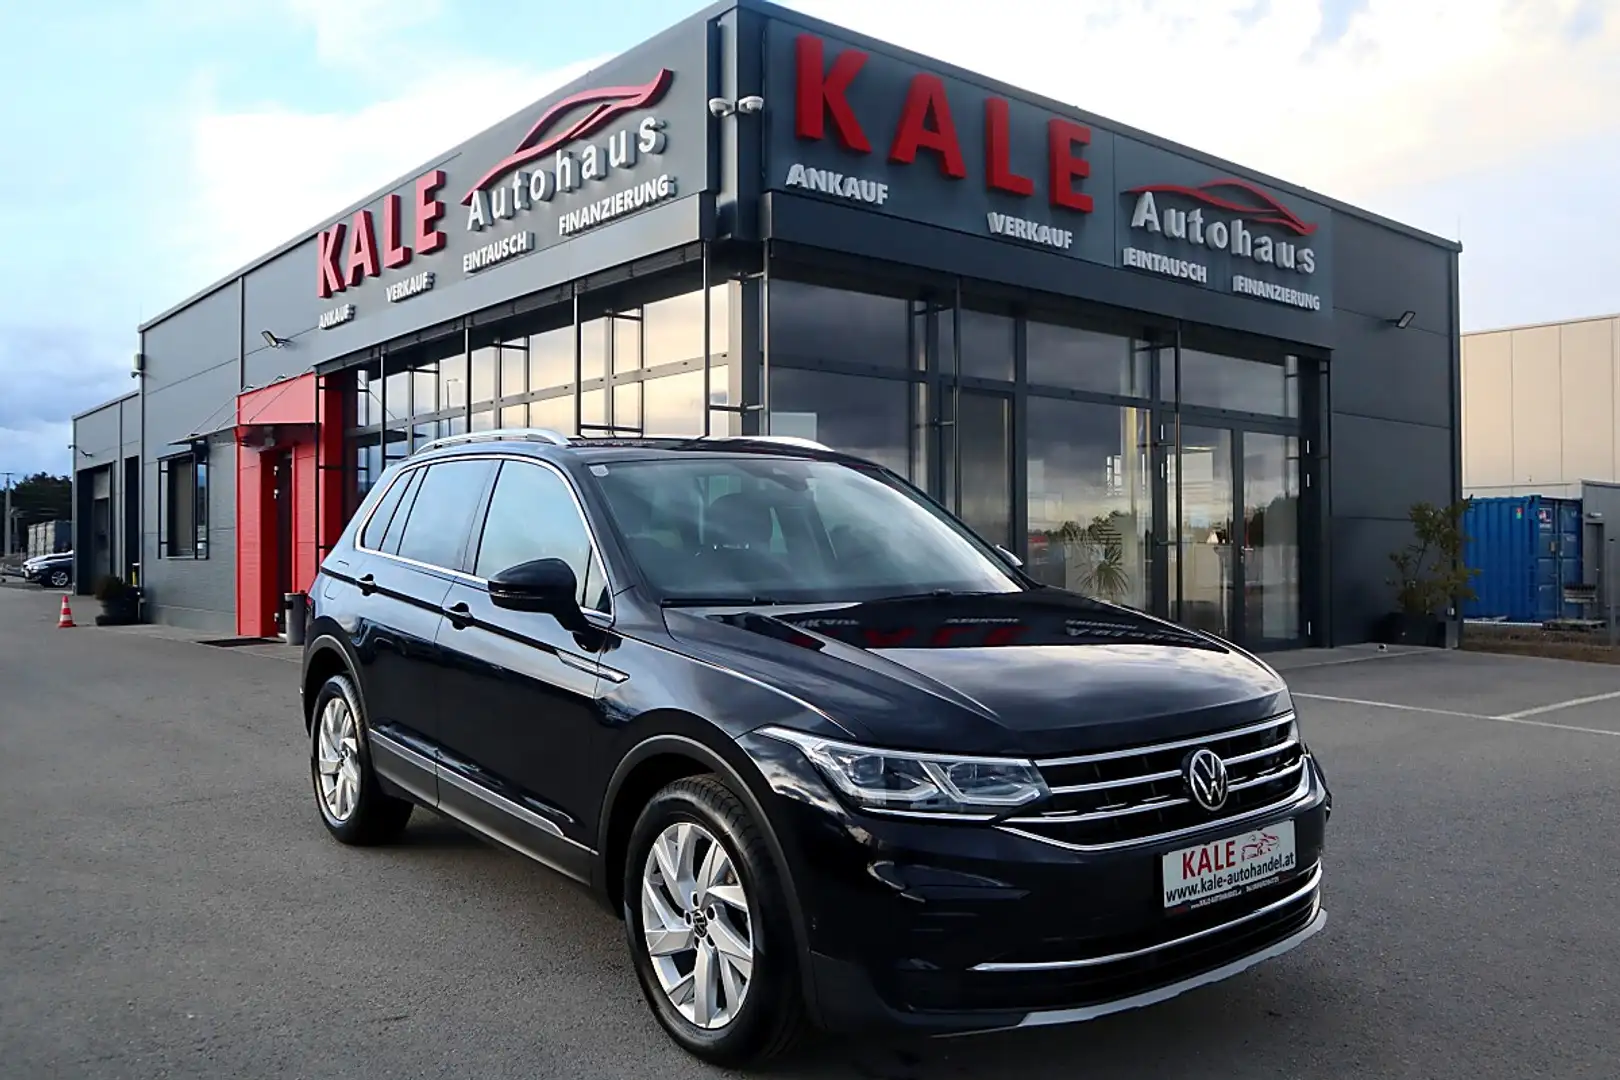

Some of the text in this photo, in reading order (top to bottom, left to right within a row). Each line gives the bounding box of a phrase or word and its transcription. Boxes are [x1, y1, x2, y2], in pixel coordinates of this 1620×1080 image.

[467, 115, 667, 232] Autohaus
[795, 33, 1094, 214] KALE
[316, 169, 447, 298] KALE
[318, 173, 678, 330] ANKAUF VERKAUF EINTAUSCH FINANZIERUNG
[786, 162, 1321, 312] ANKAUF VERKAUF EINTAUSCH FINANZIERUNG
[1131, 191, 1316, 274] Autohaus
[1165, 851, 1295, 903] www.kale-autohandel.at
[1182, 840, 1236, 880] KALE
